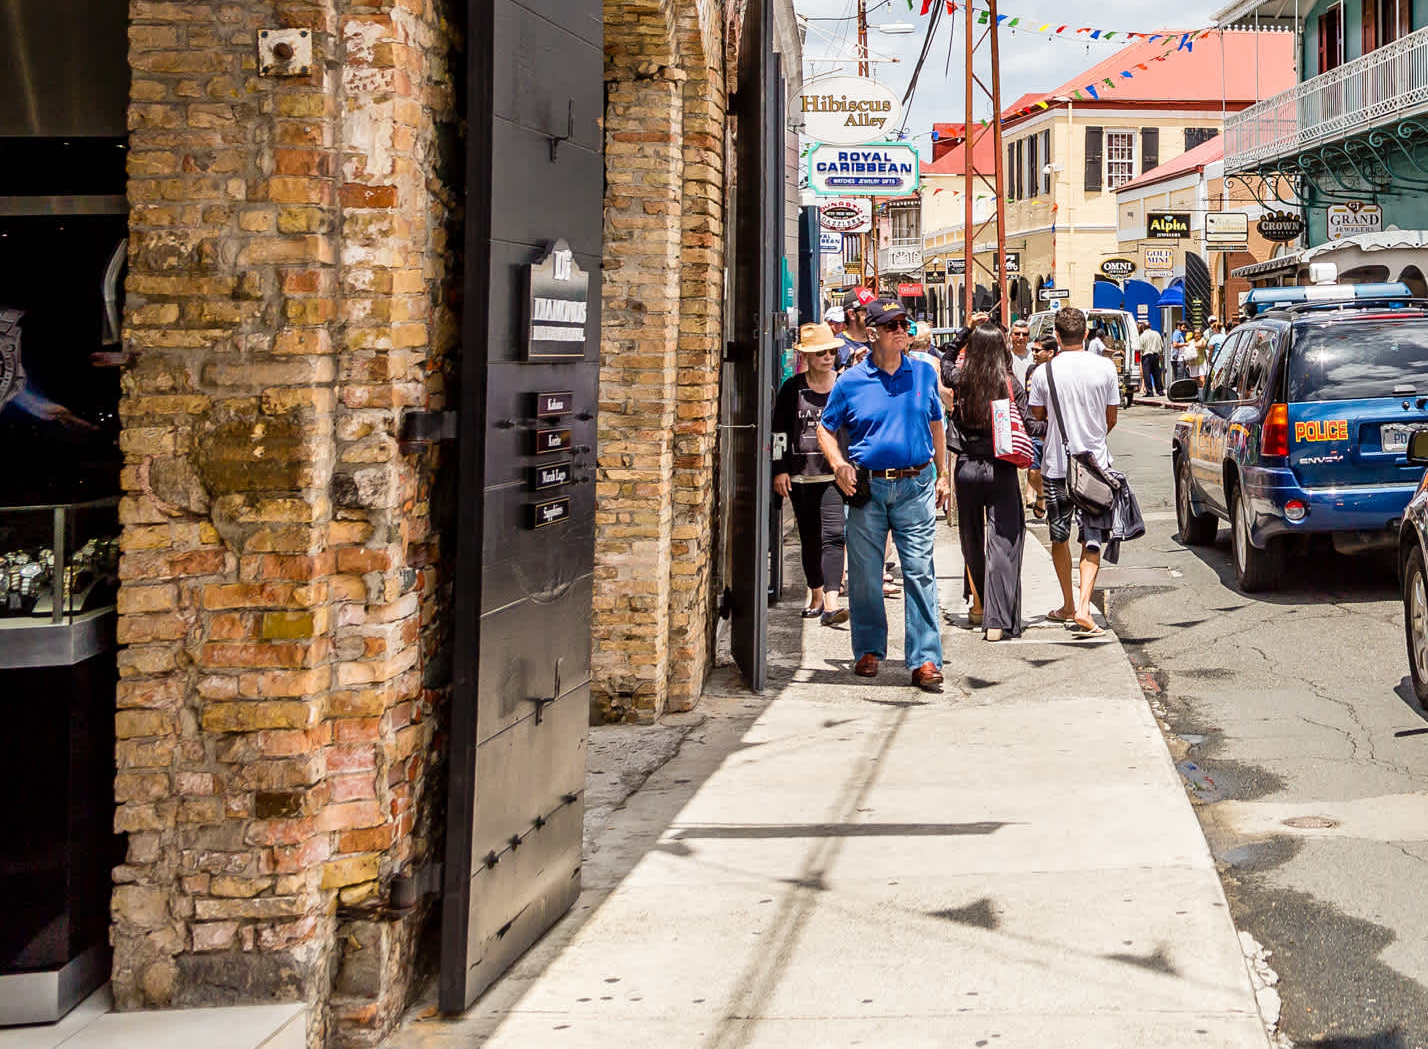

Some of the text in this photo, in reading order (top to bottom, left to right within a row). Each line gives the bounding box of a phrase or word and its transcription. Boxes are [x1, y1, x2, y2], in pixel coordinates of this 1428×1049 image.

[800, 94, 891, 113] Hibiscus
[843, 113, 887, 129] Alley
[838, 152, 892, 162] ROYAL
[817, 162, 912, 173] CARIBBEAN
[1261, 220, 1300, 230] CROWN
[1330, 214, 1379, 225] GRAND
[1103, 262, 1132, 270] OMNI
[1295, 420, 1348, 442] POLICE
